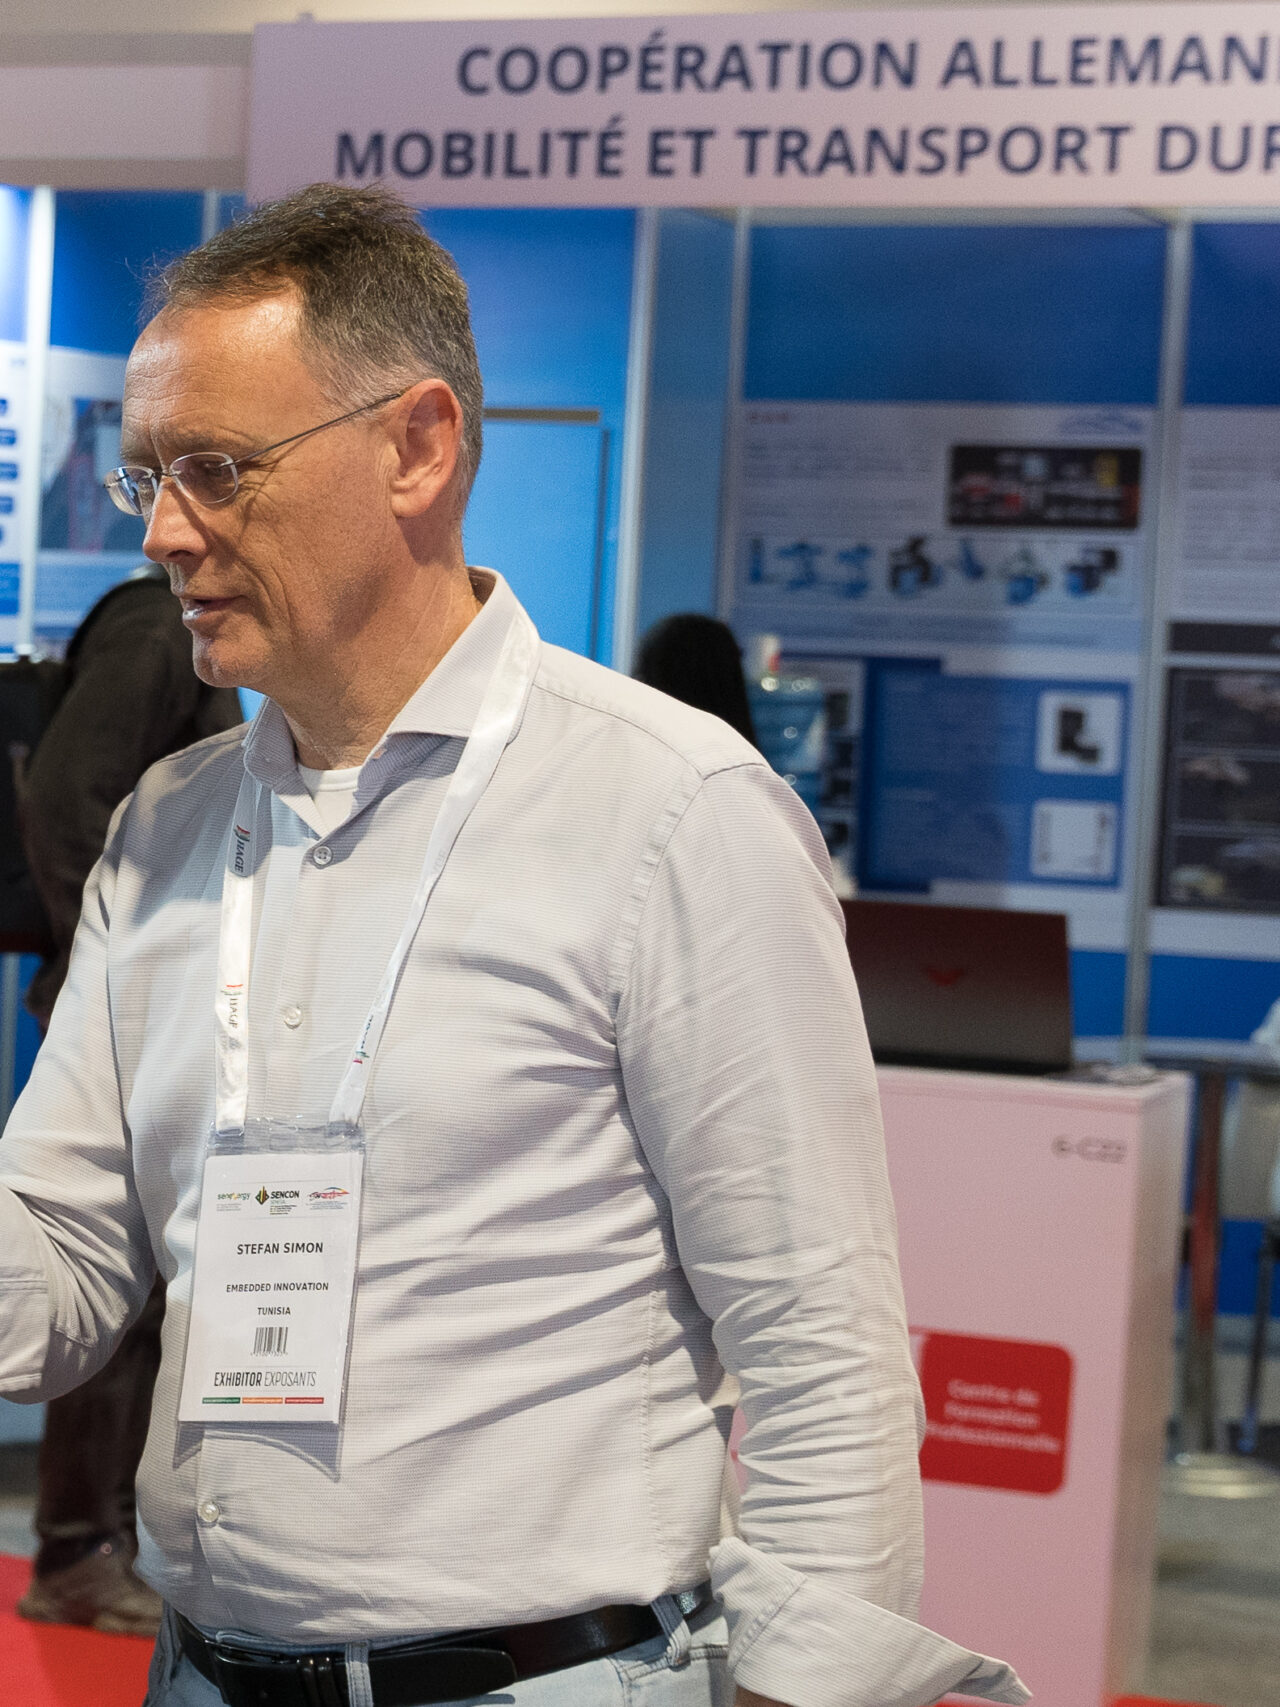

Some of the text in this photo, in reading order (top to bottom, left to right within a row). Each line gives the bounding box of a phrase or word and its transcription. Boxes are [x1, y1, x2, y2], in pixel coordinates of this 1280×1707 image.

[456, 26, 1278, 95] COOPÉRATION ALLEMAN
[336, 112, 626, 180] MOBILITÉ
[648, 127, 716, 178] ET
[737, 122, 1134, 179] TRANSPORT
[270, 1190, 300, 1200] SENCON
[236, 1242, 324, 1255] STEFAN SIMON
[226, 1282, 329, 1293] EMBEDDED INNOVATION
[257, 1306, 292, 1316] TUNISIA
[214, 1371, 317, 1387] EXHIBITOR EXPOSANTS
